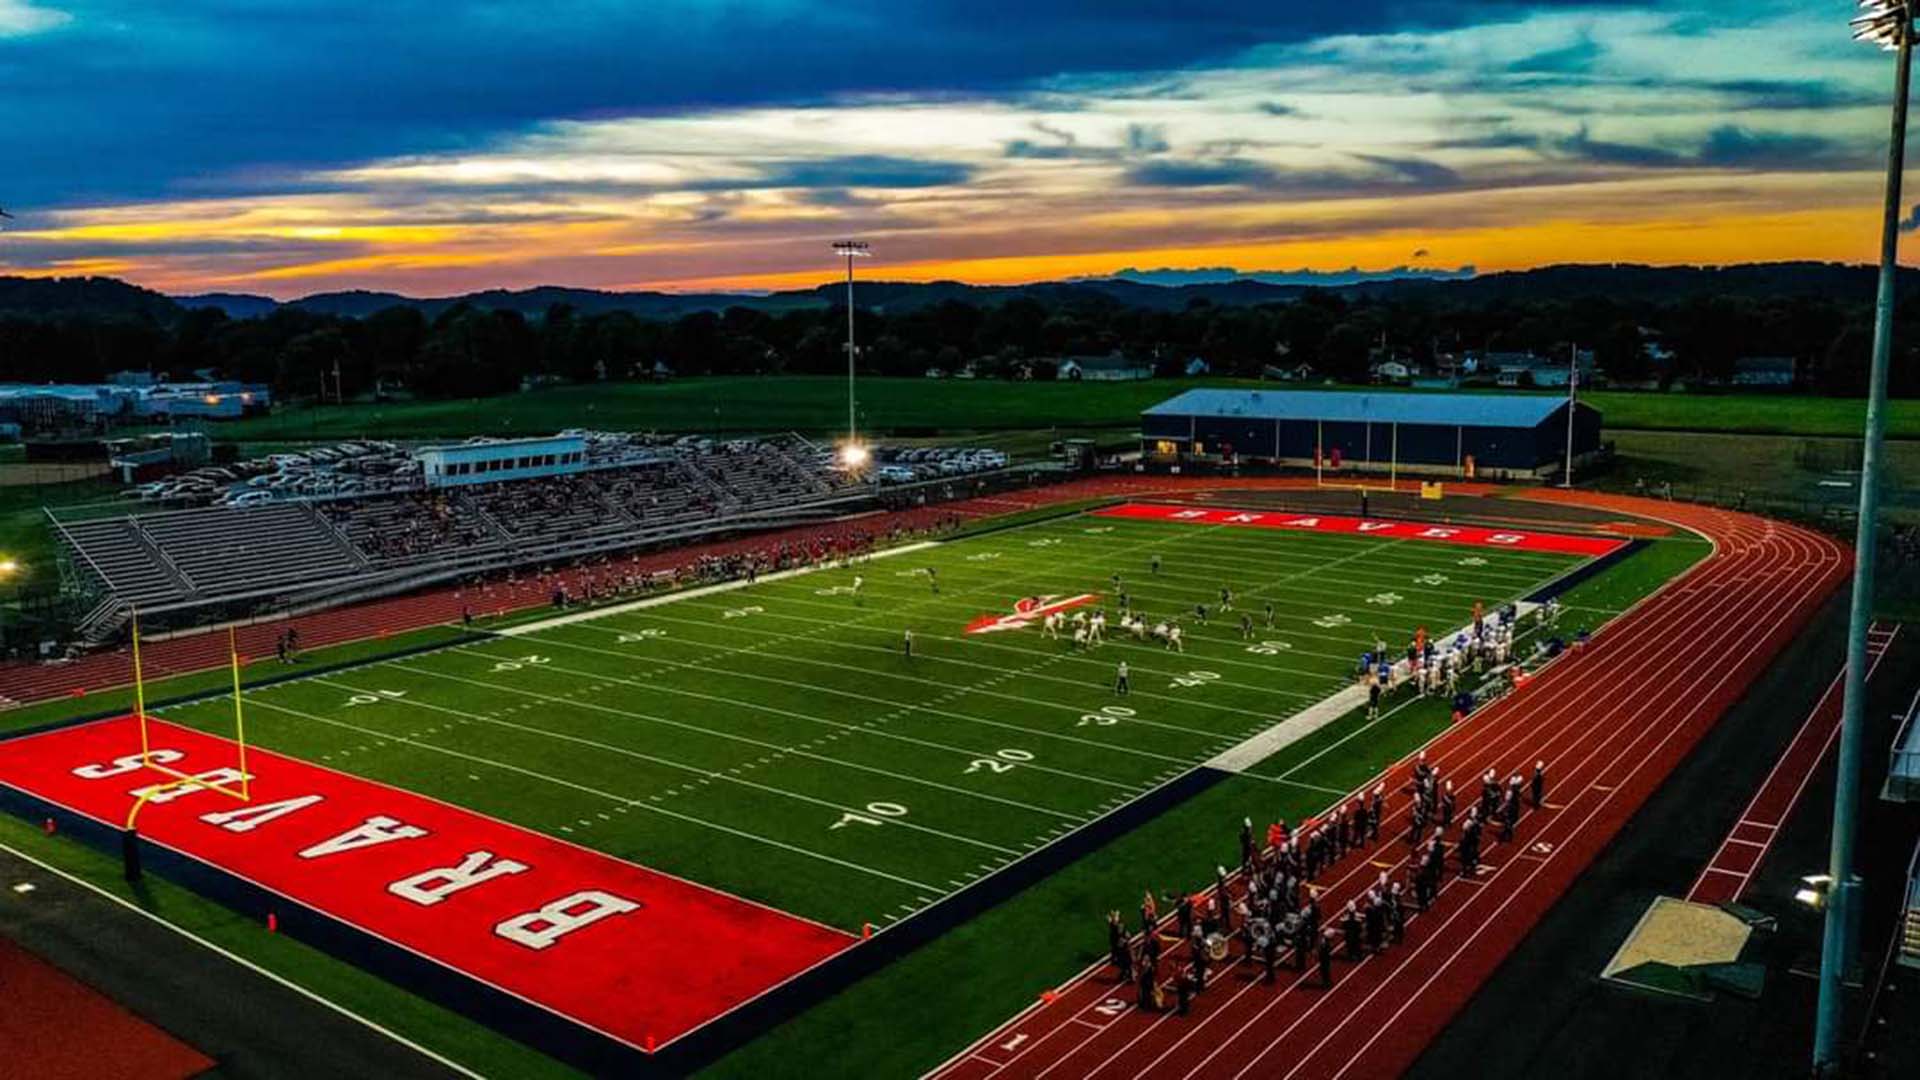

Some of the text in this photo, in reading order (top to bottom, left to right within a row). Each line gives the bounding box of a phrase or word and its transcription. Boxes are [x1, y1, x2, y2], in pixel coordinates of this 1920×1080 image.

[1079, 706, 1137, 726] 30
[970, 748, 1035, 772] 20
[842, 801, 908, 826] 10
[72, 748, 640, 950] BRAVES
[1094, 998, 1127, 1015] 2
[1000, 1033, 1029, 1051] 1
